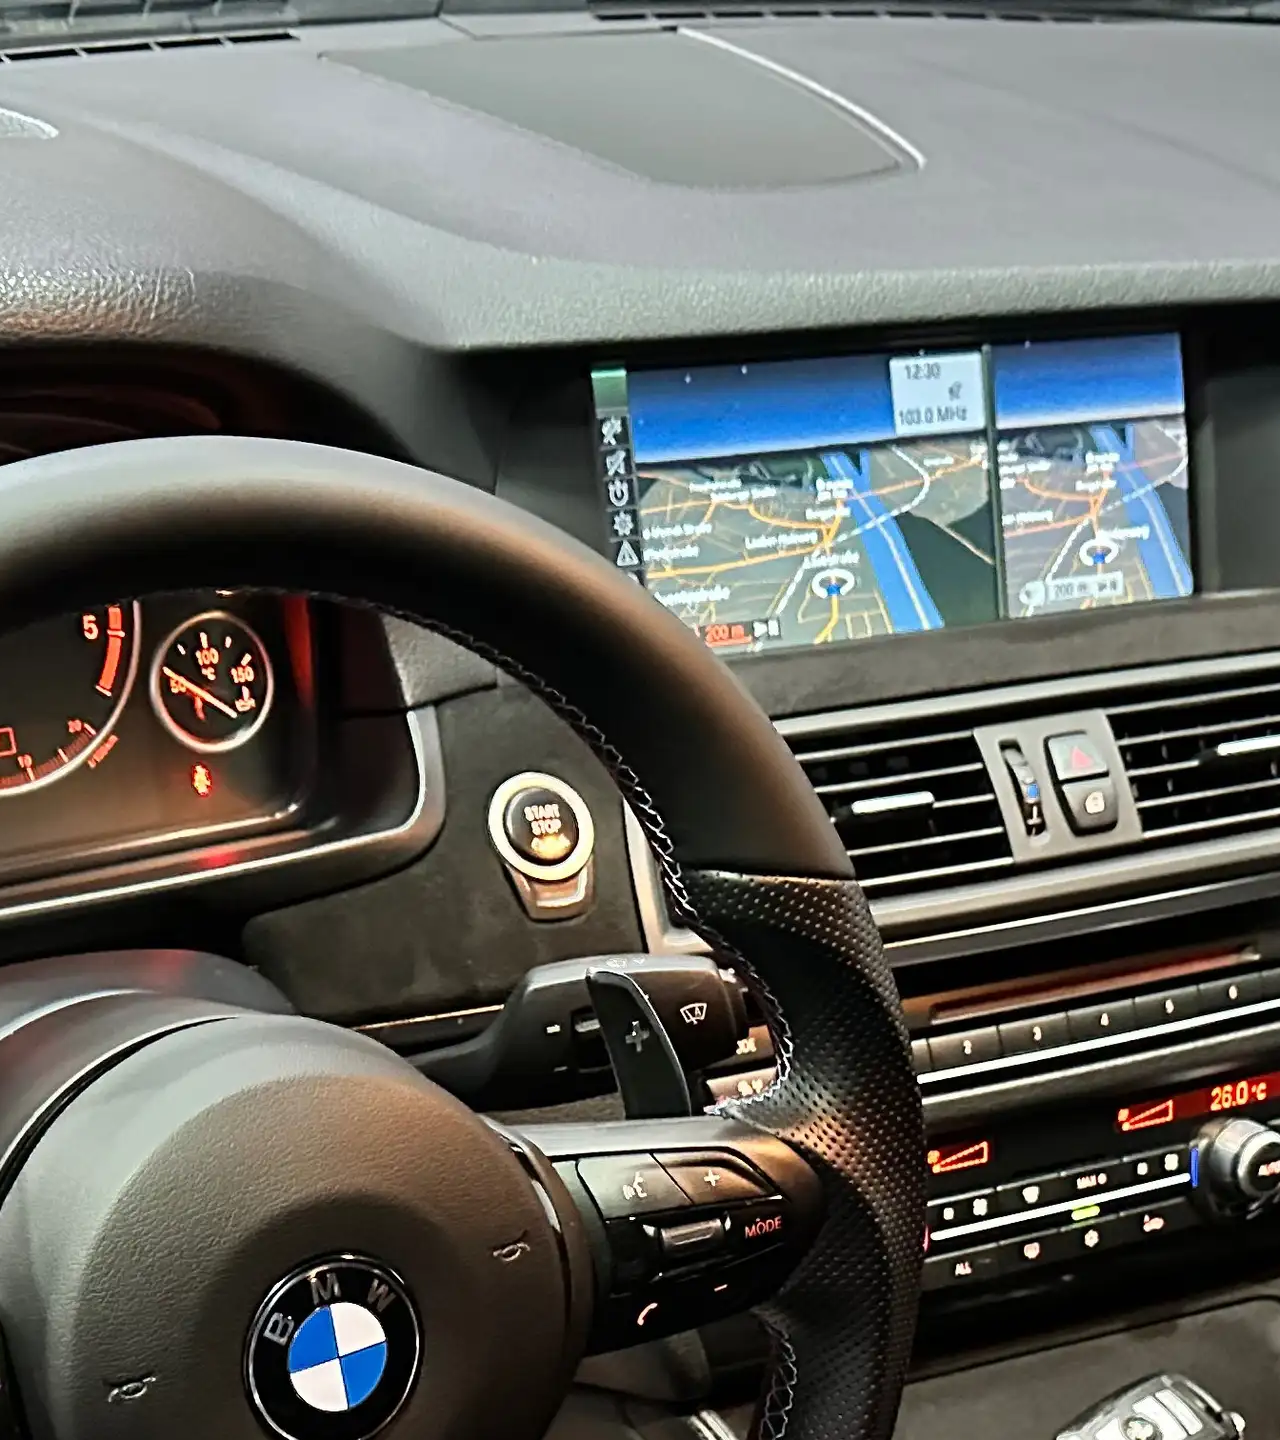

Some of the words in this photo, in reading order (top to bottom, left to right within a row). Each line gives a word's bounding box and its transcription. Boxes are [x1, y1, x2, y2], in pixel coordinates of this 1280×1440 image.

[904, 362, 941, 380] 12:30
[936, 405, 968, 423] MHz
[82, 614, 99, 640] 5
[195, 648, 219, 665] 100
[230, 668, 255, 684] 150
[523, 803, 562, 821] START
[531, 818, 562, 836] STOP
[1209, 1081, 1249, 1111] 26.0
[744, 1214, 783, 1241] MODE
[263, 1271, 397, 1347] BMW
